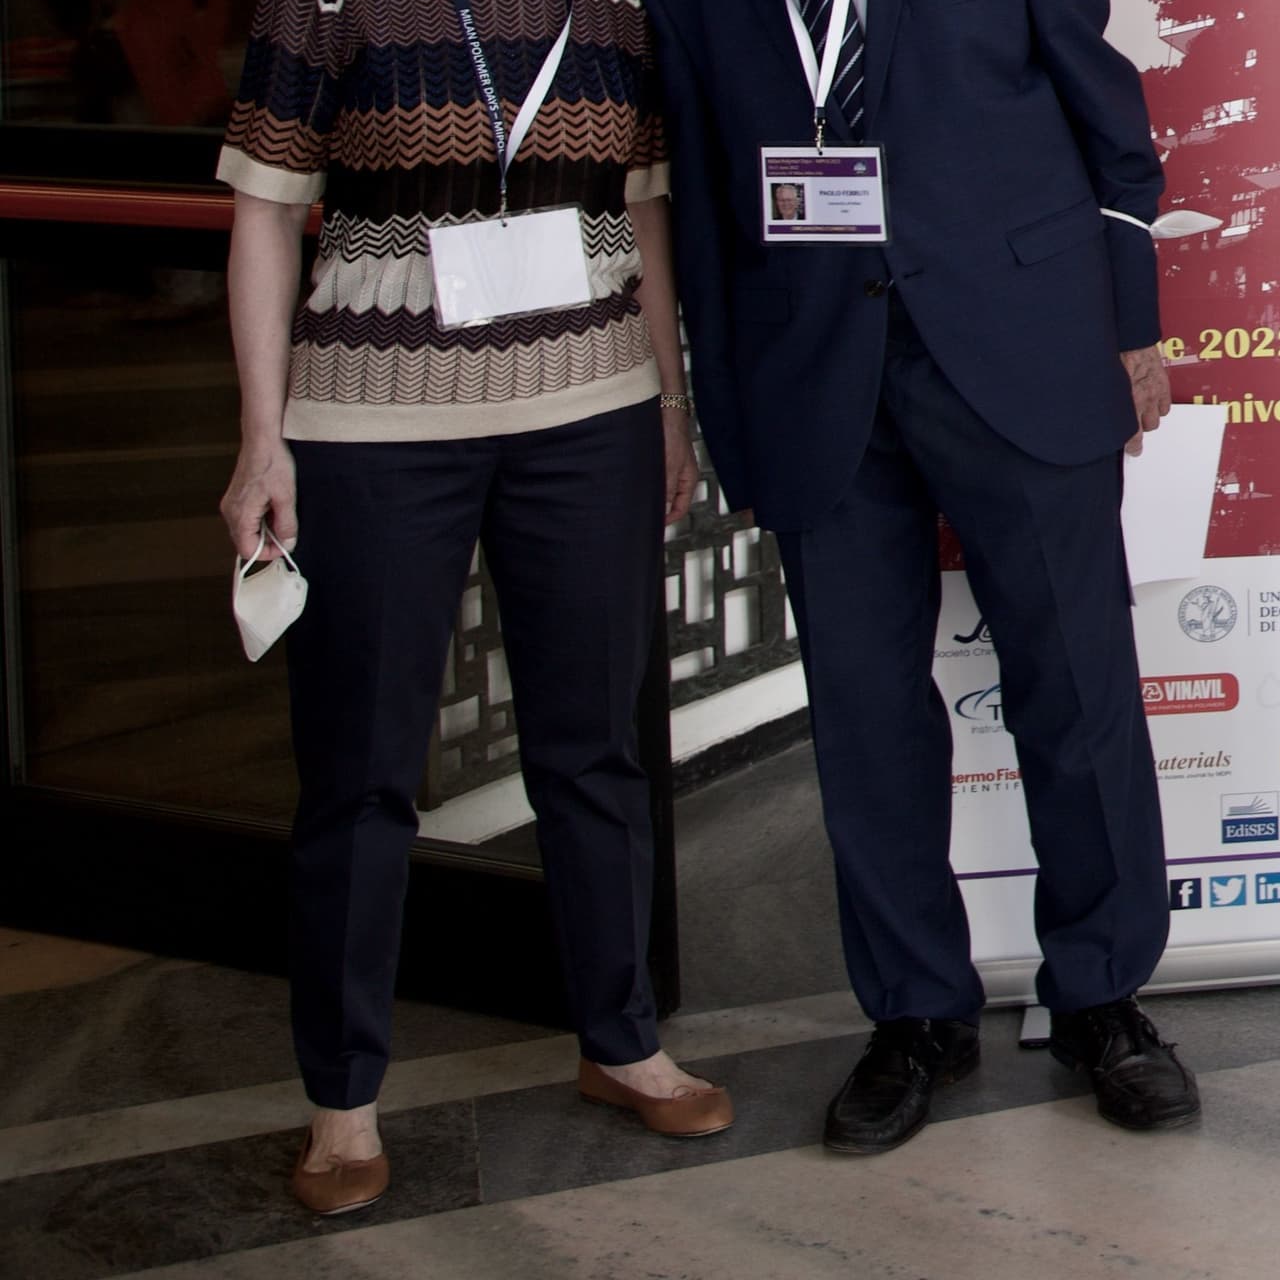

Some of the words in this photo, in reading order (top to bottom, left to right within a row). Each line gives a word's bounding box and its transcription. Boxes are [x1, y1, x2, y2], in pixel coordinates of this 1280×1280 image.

[460, 8, 477, 41] MILAN
[471, 41, 491, 88] POLYMER
[484, 86, 499, 115] DAYS
[493, 121, 505, 154] MIPOL
[1260, 620, 1275, 633] DI
[1164, 678, 1226, 701] VINAVIL
[1156, 751, 1232, 771] aterials
[1225, 823, 1276, 838] EdiSES
